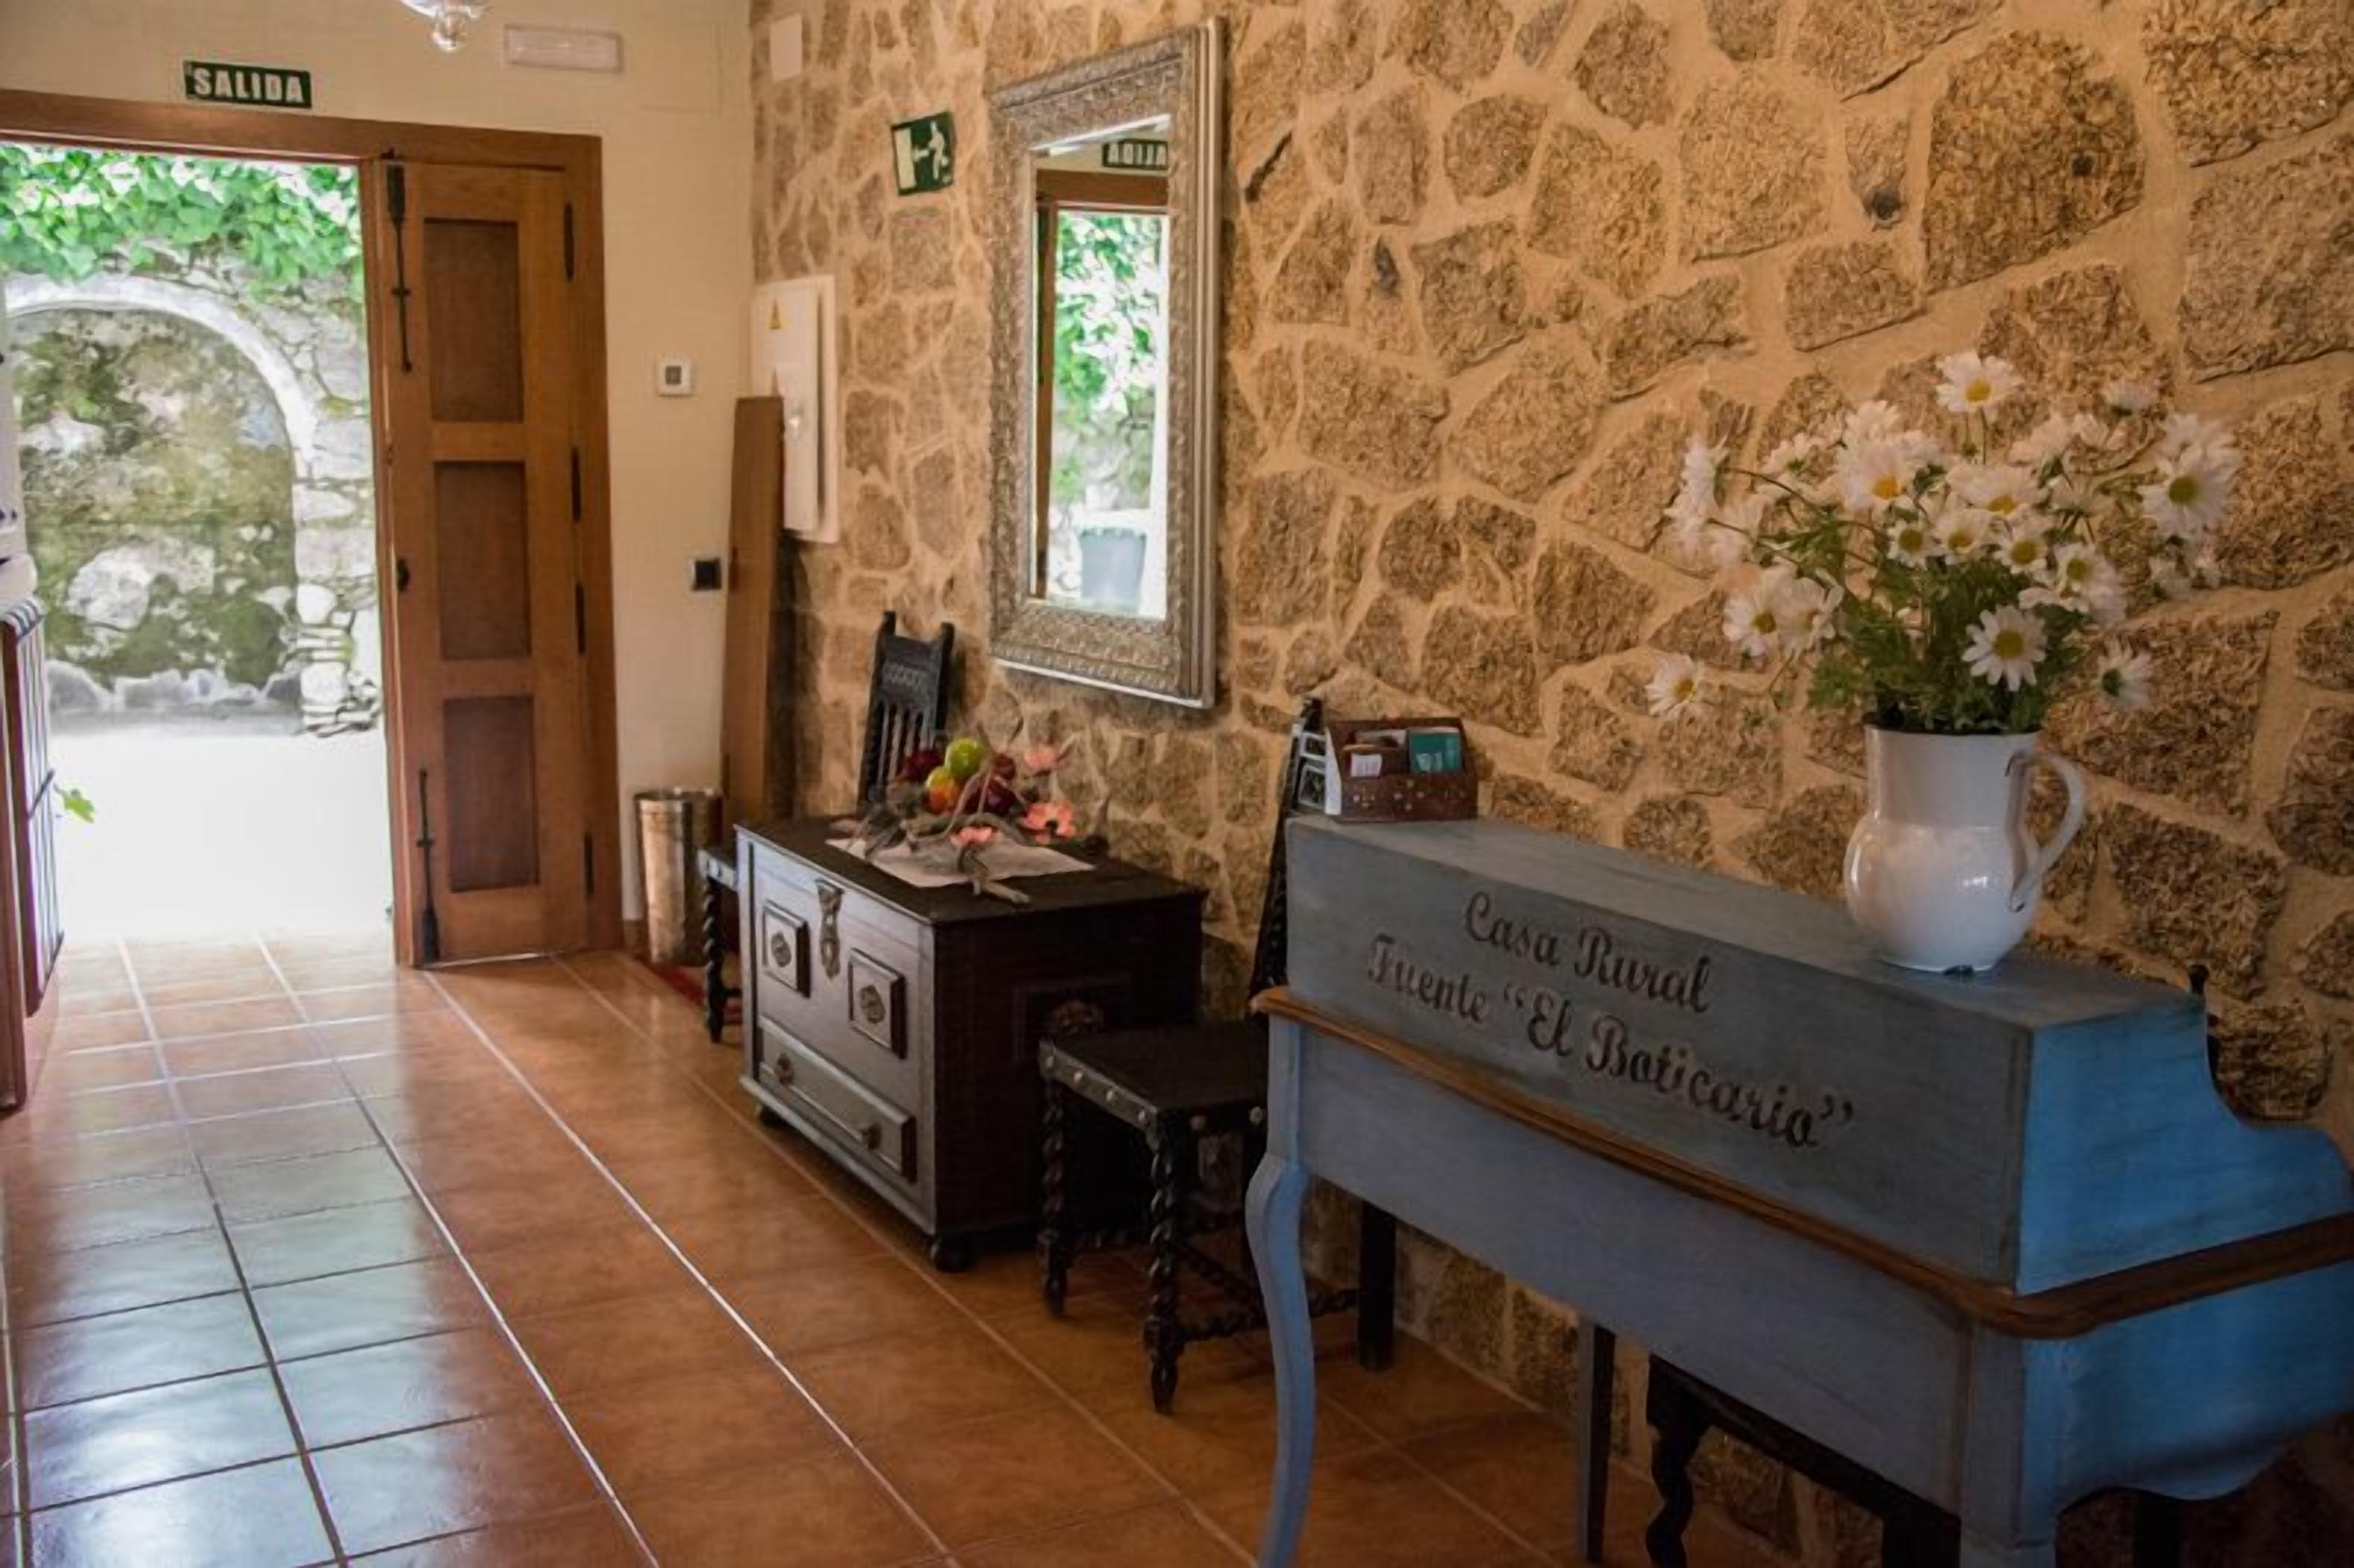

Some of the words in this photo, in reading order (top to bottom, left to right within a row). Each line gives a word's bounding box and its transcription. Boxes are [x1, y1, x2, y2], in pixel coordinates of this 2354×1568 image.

[193, 68, 305, 103] SALIDA
[1368, 932, 1486, 1023] Fuente
[1465, 891, 1560, 966] Casa
[1574, 926, 1711, 1013] Rural
